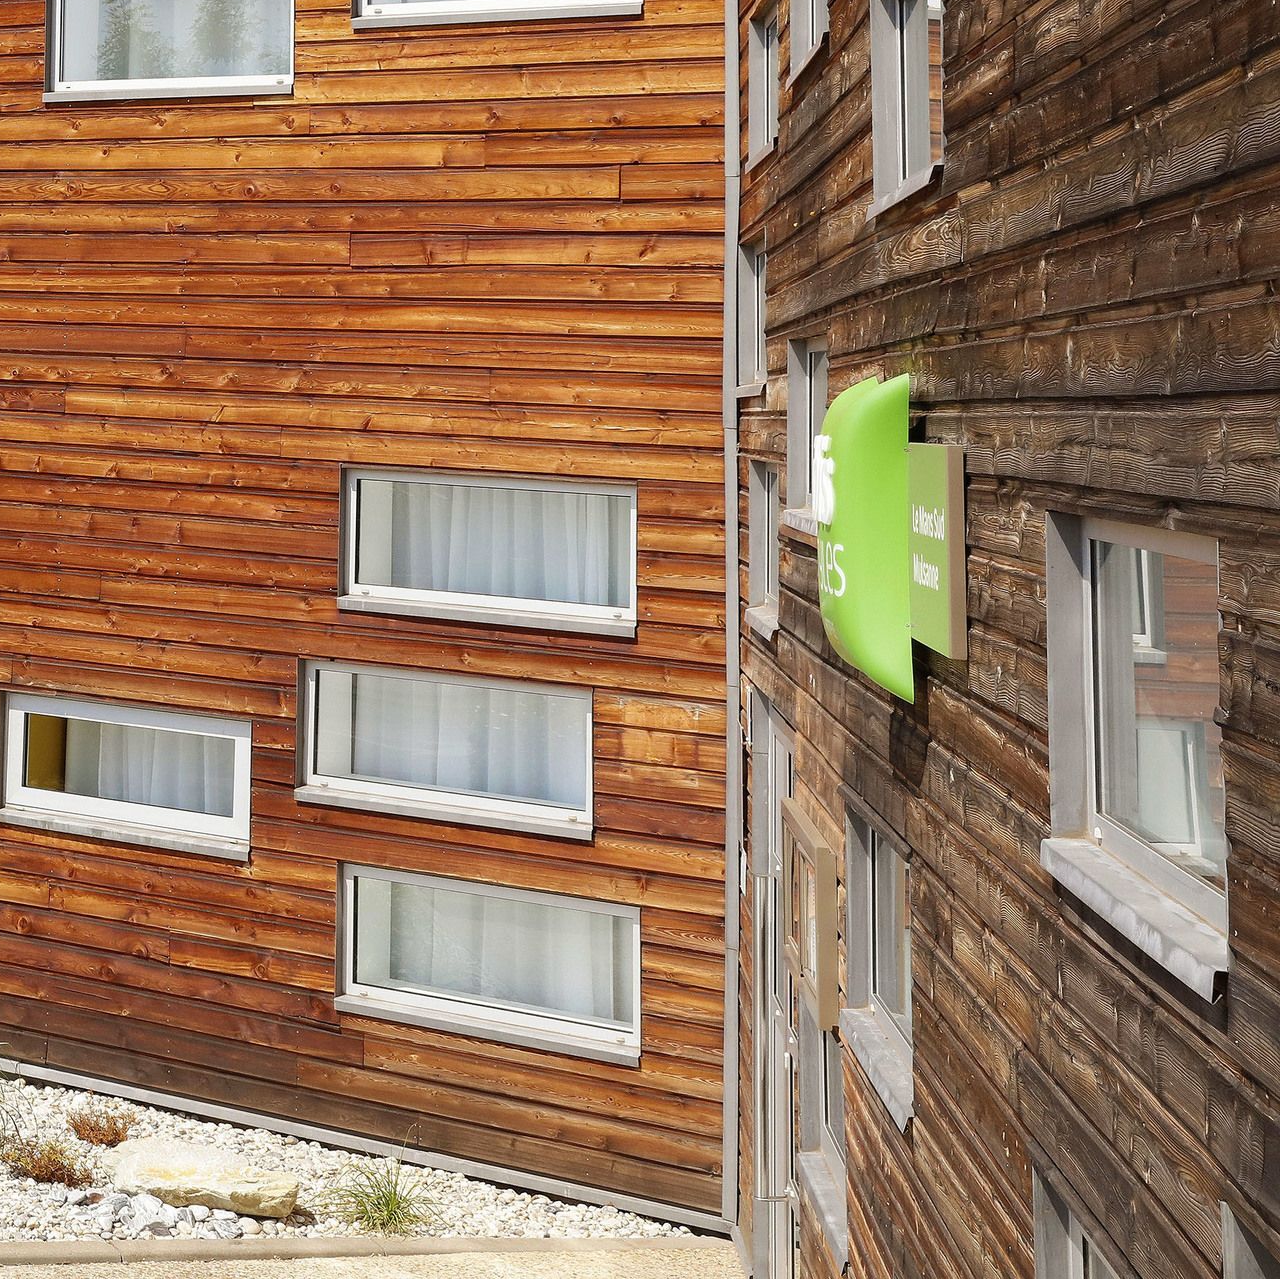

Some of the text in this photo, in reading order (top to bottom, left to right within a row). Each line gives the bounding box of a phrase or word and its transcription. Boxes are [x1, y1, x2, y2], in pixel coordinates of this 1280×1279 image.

[912, 504, 944, 541] Le Mans Sud
[913, 553, 939, 591] Mulsanne
